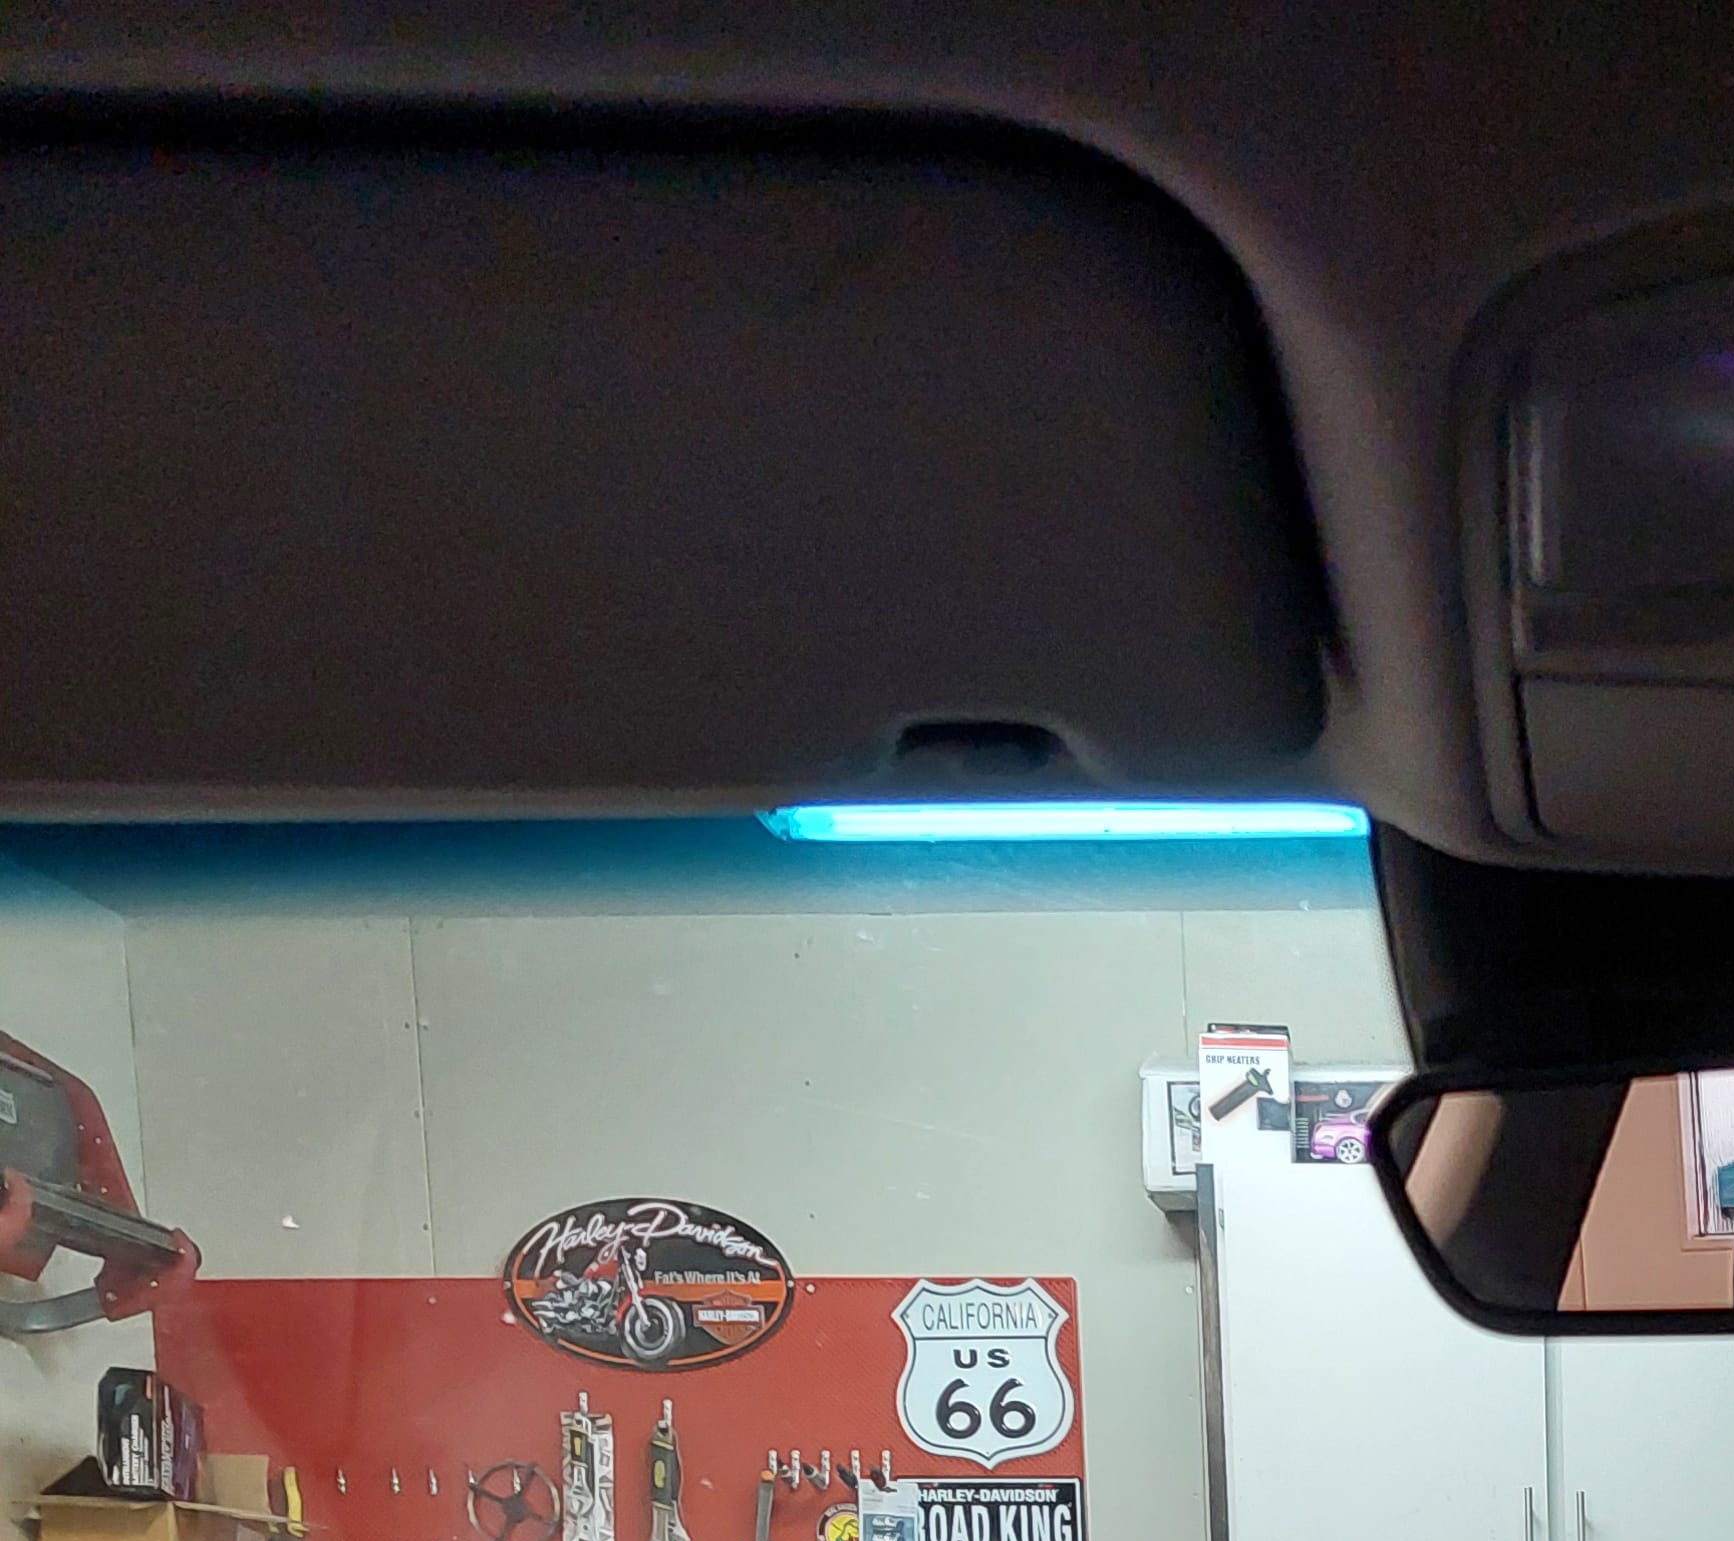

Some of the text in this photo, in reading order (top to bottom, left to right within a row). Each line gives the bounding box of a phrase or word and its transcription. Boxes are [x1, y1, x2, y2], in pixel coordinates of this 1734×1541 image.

[1205, 1055, 1225, 1065] GRIP
[521, 1202, 779, 1278] Harley-Davidson
[922, 1302, 1038, 1331] CALIFORNIA
[935, 1377, 1037, 1440] 66
[919, 1489, 1058, 1503] HARLEY-DAVIDSON
